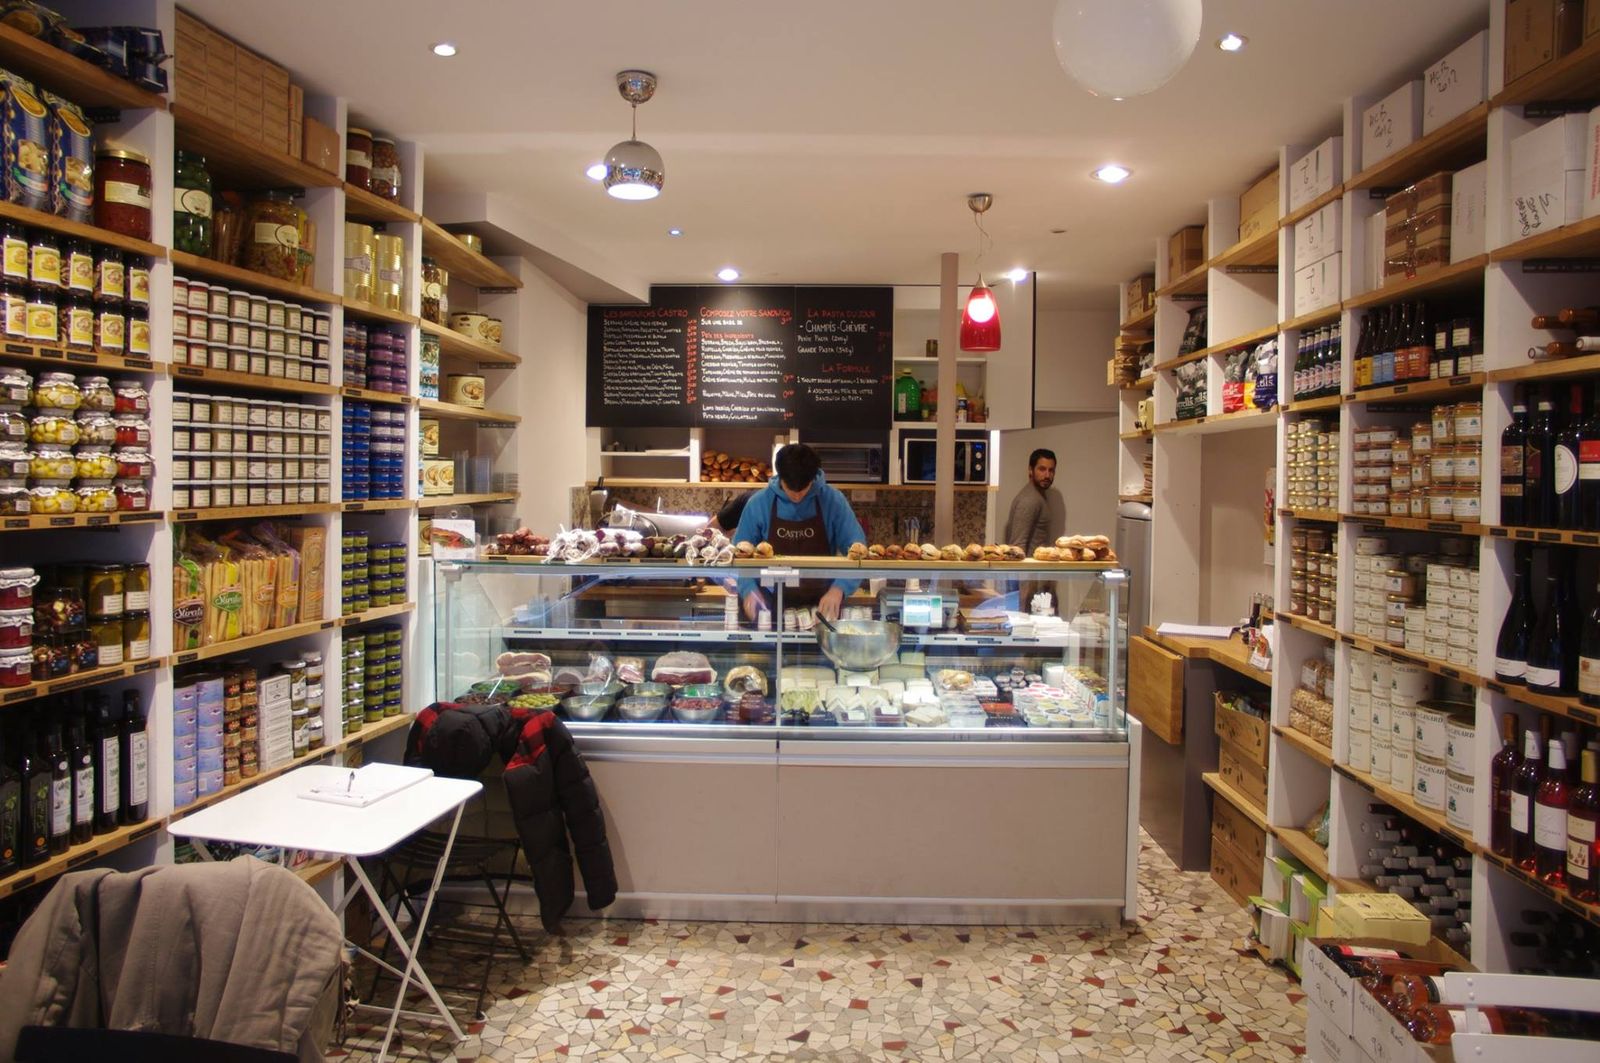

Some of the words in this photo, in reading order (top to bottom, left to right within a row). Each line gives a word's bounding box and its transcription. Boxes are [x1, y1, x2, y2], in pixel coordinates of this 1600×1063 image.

[657, 308, 688, 318] CASTRO
[700, 306, 735, 318] COMPOSEZ
[735, 309, 757, 317] VOTRE
[807, 308, 819, 318] LA
[701, 318, 711, 326] SUR
[814, 334, 829, 342] PASTA
[797, 345, 817, 354] GRANDE
[818, 345, 835, 354] PASTA
[821, 363, 833, 373] LA
[836, 363, 871, 373] FORMULE
[776, 527, 815, 539] CASTRO
